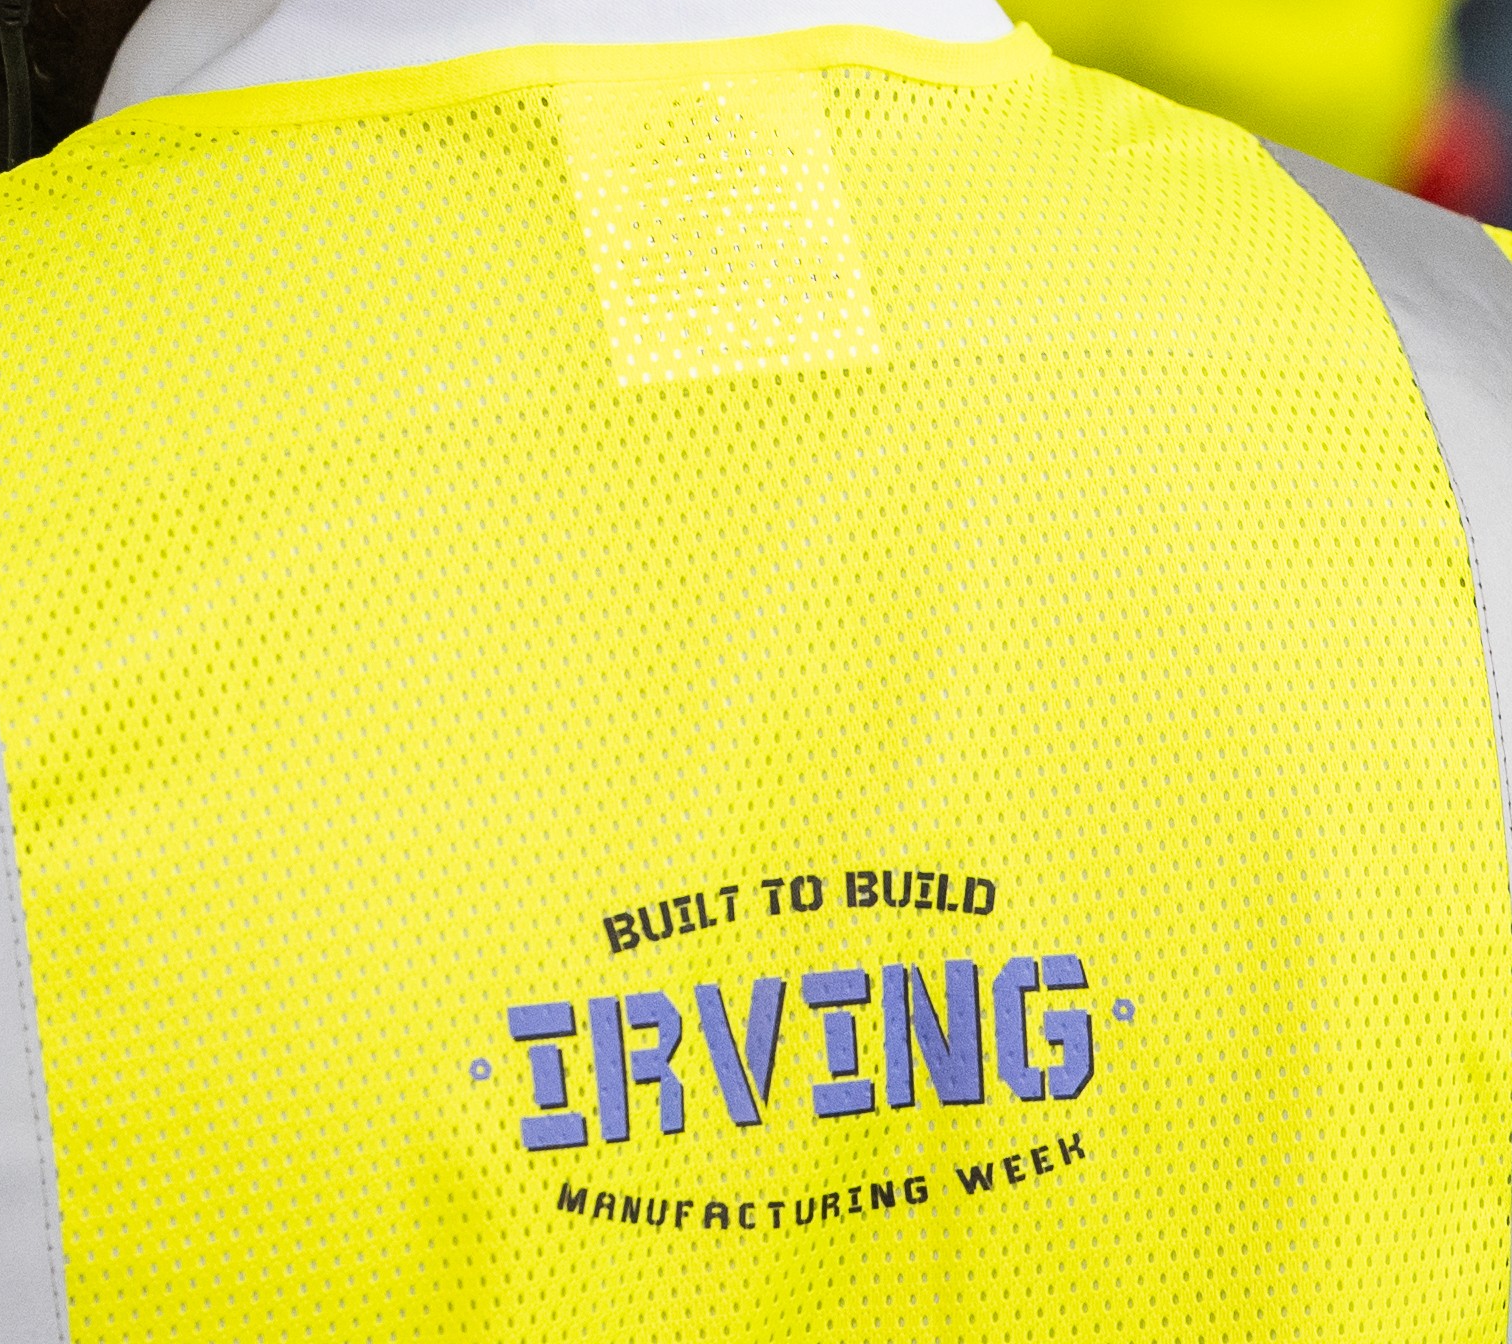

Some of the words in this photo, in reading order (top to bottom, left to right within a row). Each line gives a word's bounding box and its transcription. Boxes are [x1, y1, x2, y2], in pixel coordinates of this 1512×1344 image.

[603, 885, 740, 953] BUILT
[760, 874, 824, 915] TO
[844, 871, 997, 916] BUILD
[506, 953, 1095, 1152] IRVING
[557, 1175, 930, 1230] MANUFACTURING
[956, 1133, 1088, 1196] WEEK
